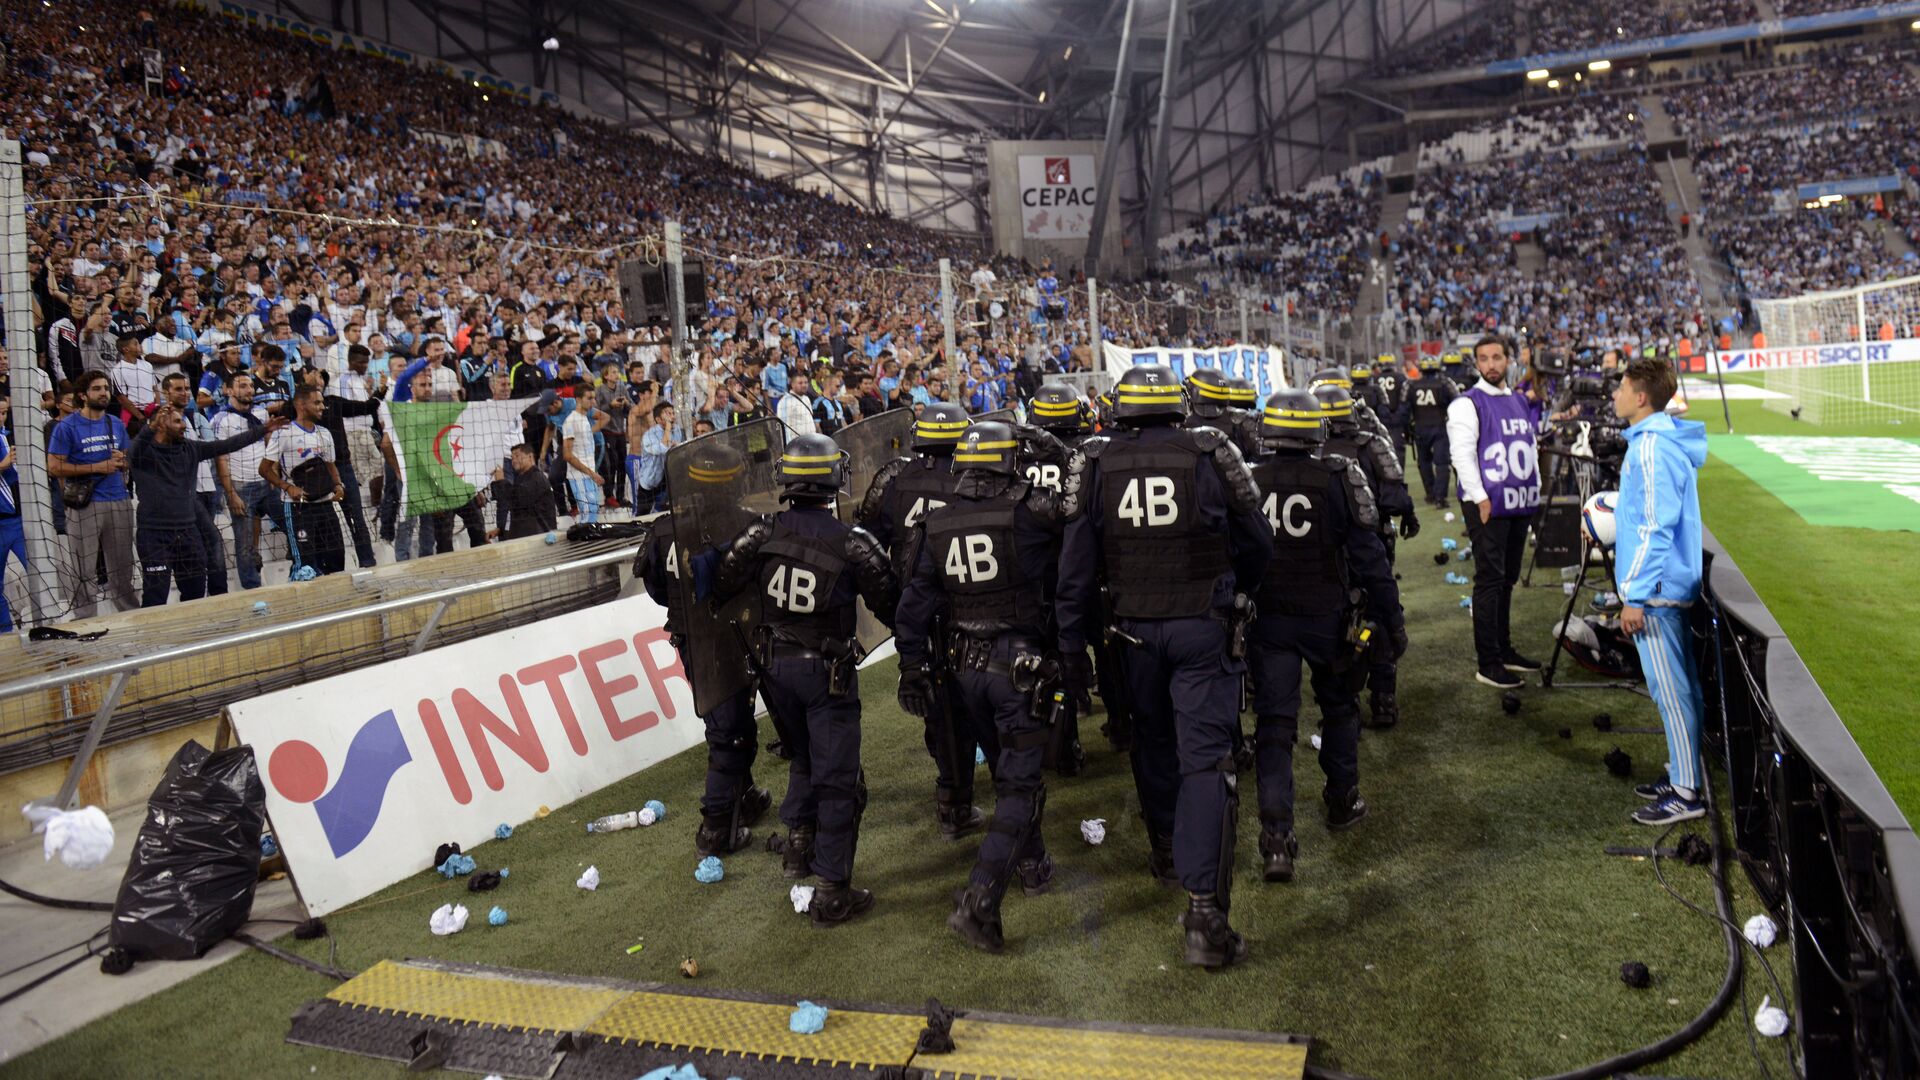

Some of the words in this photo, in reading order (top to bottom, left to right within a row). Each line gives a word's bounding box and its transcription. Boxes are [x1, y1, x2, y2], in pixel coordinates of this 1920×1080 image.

[1023, 186, 1095, 207] CEPAC
[1749, 344, 1891, 369] INTERSPORT
[1416, 389, 1437, 406] 2A
[1025, 464, 1062, 493] 2B
[1484, 440, 1534, 483] 30
[1118, 476, 1179, 528] 4B
[1262, 492, 1312, 538] 4C
[945, 534, 998, 584] 4B
[767, 564, 817, 613] 4B
